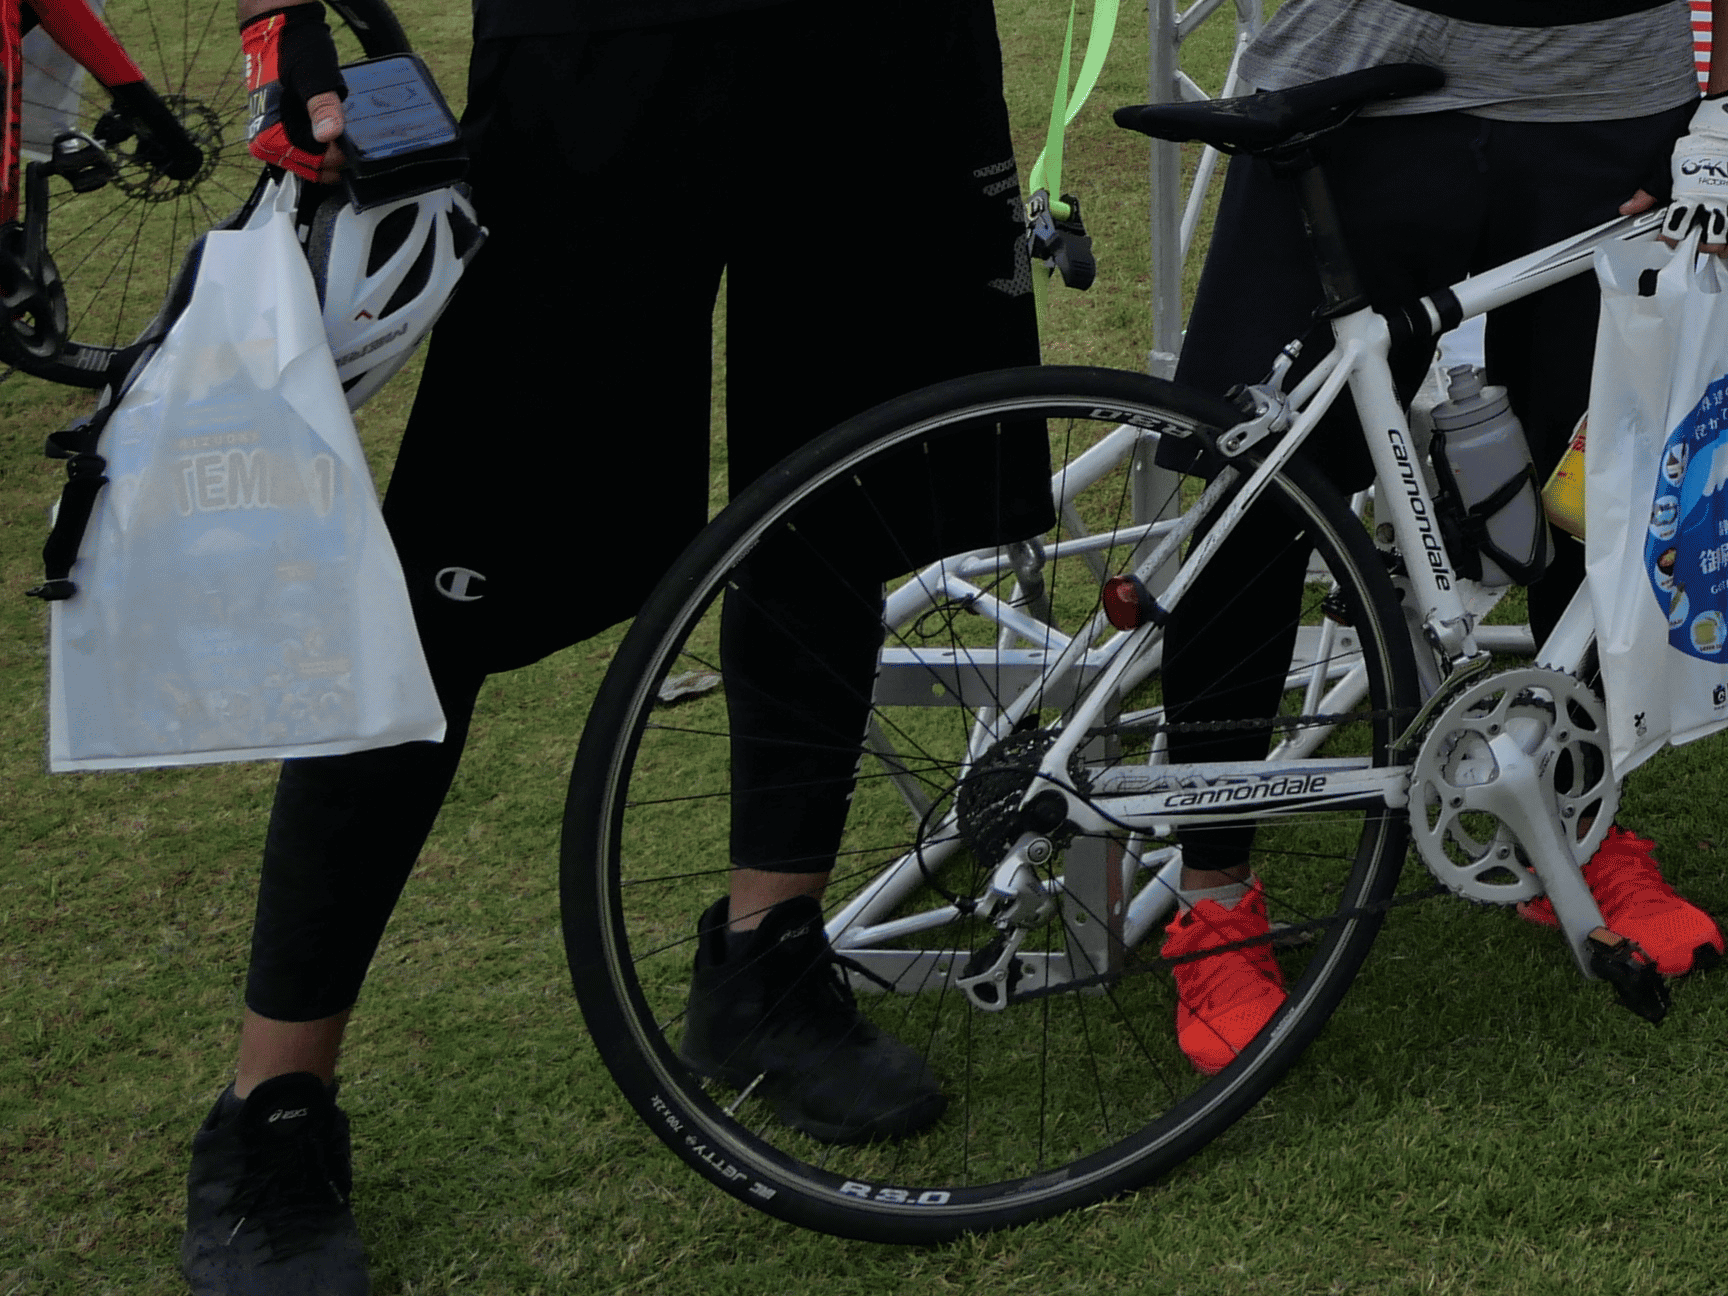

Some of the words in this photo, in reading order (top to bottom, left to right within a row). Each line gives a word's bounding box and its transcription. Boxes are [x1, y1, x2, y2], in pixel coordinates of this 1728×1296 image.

[1387, 428, 1451, 592] cannondale
[1164, 774, 1327, 808] cannondale
[838, 1180, 952, 1206] R3.0
